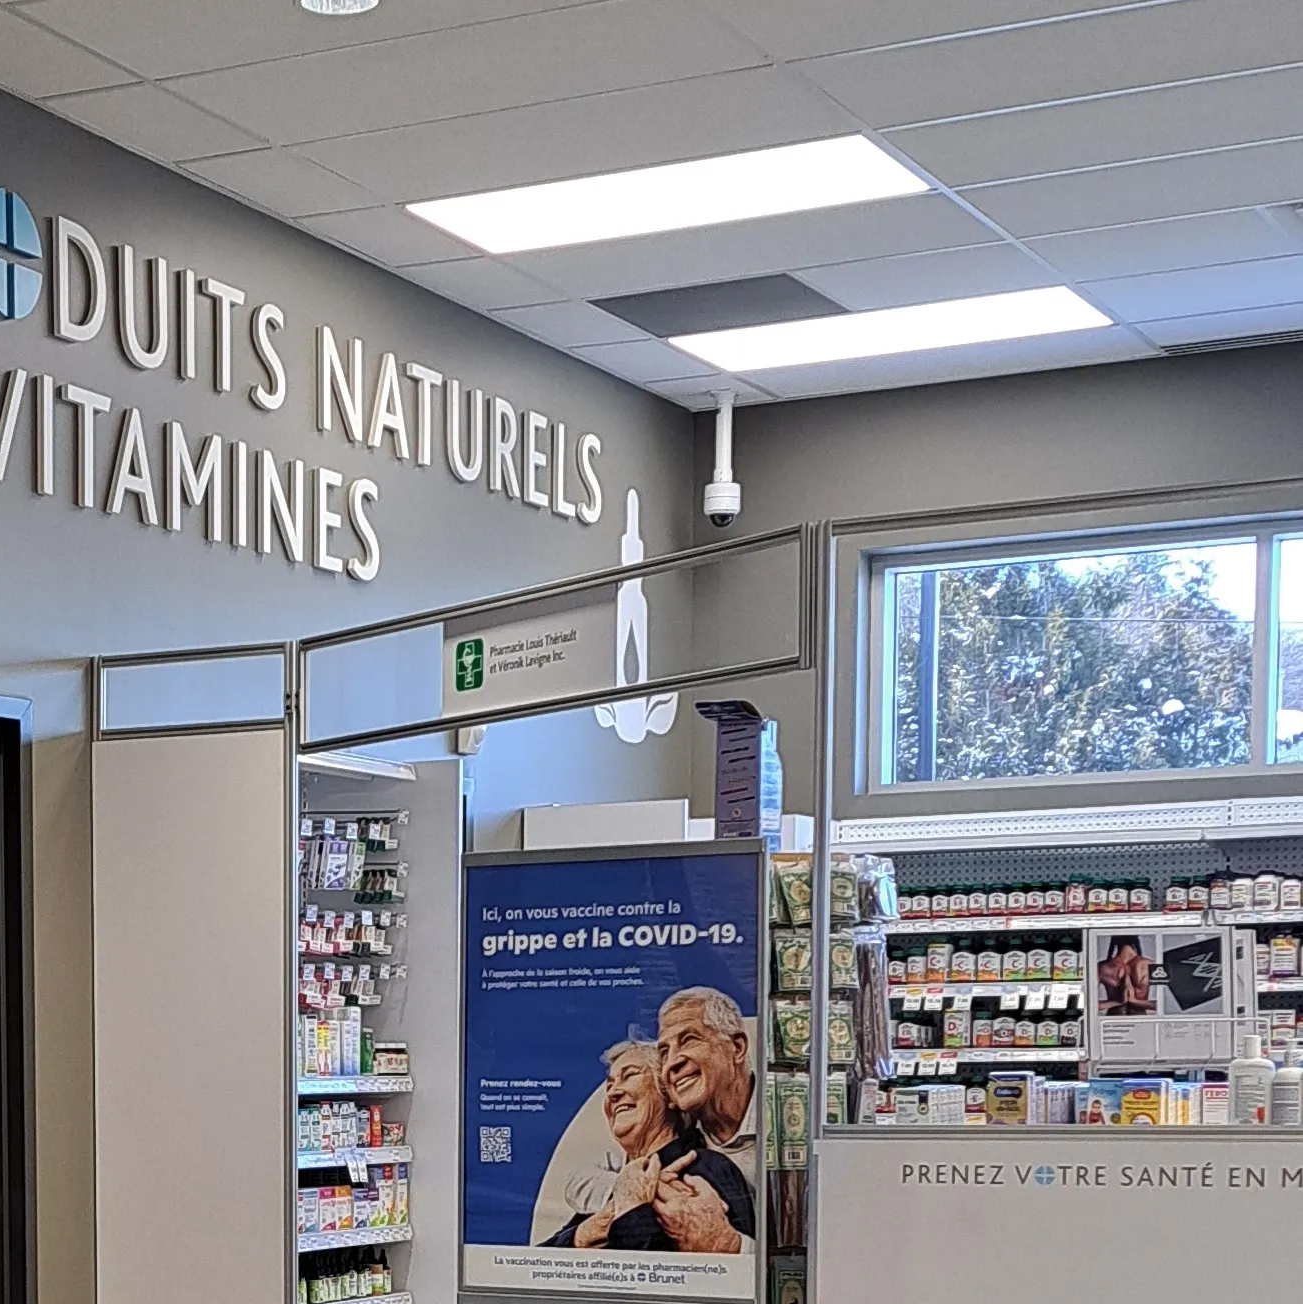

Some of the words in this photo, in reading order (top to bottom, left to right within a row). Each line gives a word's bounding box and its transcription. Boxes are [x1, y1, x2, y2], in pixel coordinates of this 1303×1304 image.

[317, 324, 602, 523] NATURELS
[489, 640, 524, 657] Pharmacie
[526, 636, 543, 650] Louis
[544, 629, 577, 646] Thériault
[489, 661, 497, 674] et
[525, 653, 551, 668] Lavigne
[552, 650, 565, 661] Inc.
[482, 907, 502, 923] Ici,
[505, 909, 523, 920] on
[526, 908, 559, 919] vous
[561, 903, 615, 918] vaccine
[617, 901, 664, 916] contre
[668, 900, 681, 914] la
[482, 929, 558, 956] grippe
[563, 928, 588, 949] et
[592, 927, 613, 947] la
[618, 923, 744, 947] COVID-19.
[480, 1079, 508, 1088] Prenez
[510, 1079, 562, 1088] rendez-vous
[901, 1164, 1004, 1185] PRENEZ
[1015, 1165, 1108, 1187] VOTRE
[1120, 1162, 1214, 1188] SANTÉ
[1228, 1167, 1266, 1188] EN
[494, 1256, 504, 1265] La
[506, 1257, 552, 1267] vaccination
[554, 1260, 573, 1268] vous
[576, 1260, 589, 1268] est
[591, 1260, 620, 1269] offerte
[622, 1263, 636, 1271] par
[638, 1262, 650, 1270] les
[653, 1262, 727, 1275] pharmacien(ne)s
[533, 1270, 586, 1280] propriétaires
[649, 1272, 685, 1284] Brunet
